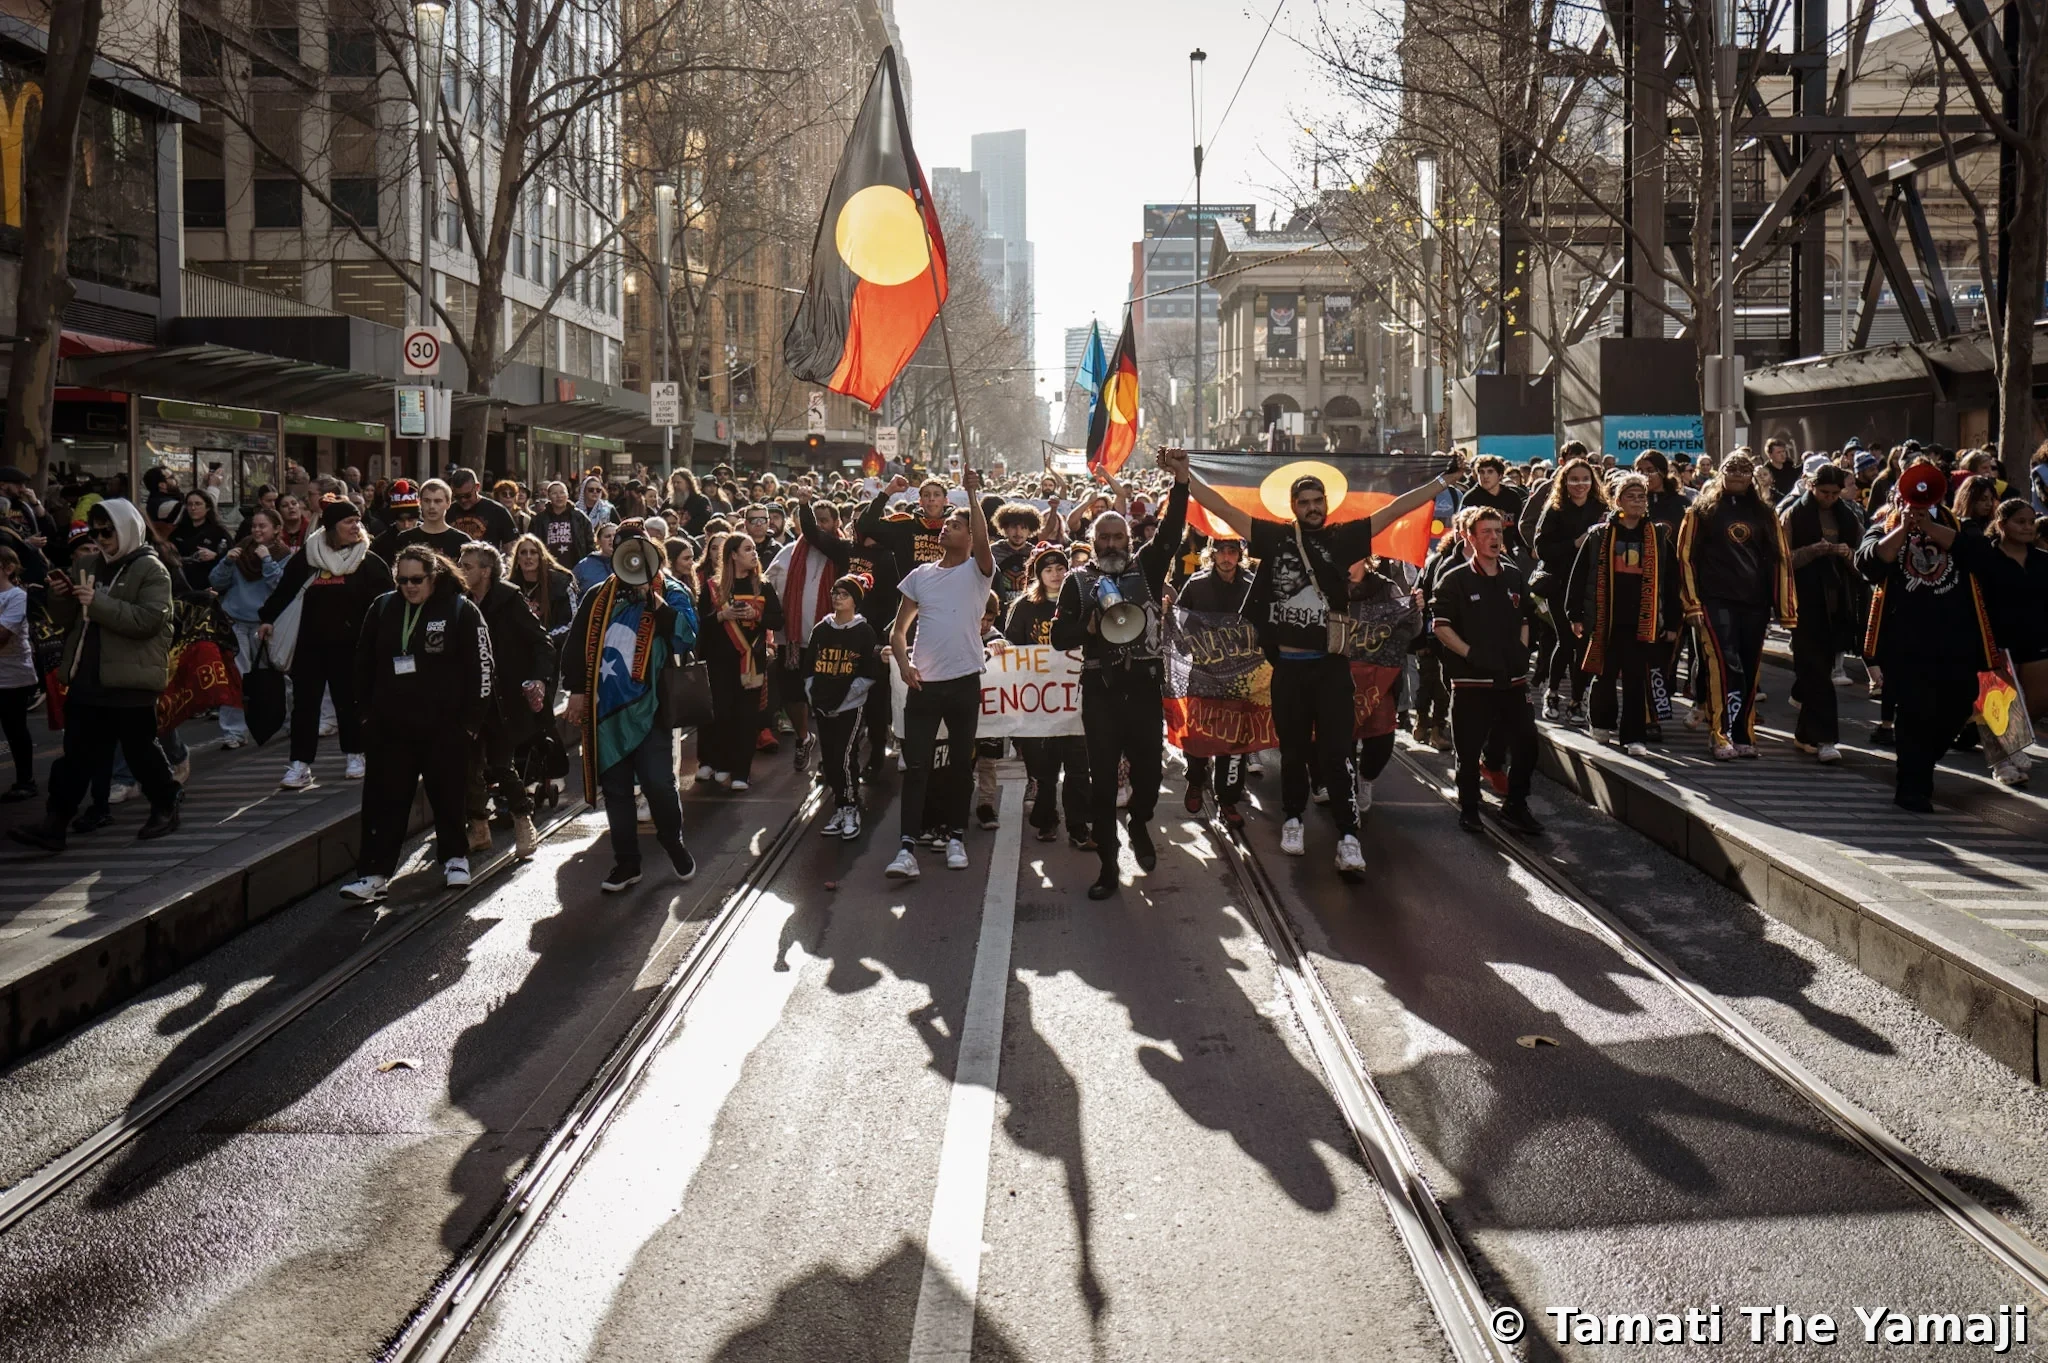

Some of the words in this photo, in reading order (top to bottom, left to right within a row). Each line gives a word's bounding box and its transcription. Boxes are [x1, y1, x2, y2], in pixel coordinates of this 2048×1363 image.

[411, 342, 433, 359] 30
[1618, 430, 1650, 439] MORE
[1652, 430, 1694, 439] TRAINS
[1618, 440, 1657, 450] MORE
[1659, 440, 1704, 450] OFTEN
[390, 492, 418, 502] EAT
[1184, 625, 1261, 667] ALW
[994, 649, 1050, 673] THE
[1065, 650, 1083, 674] S
[196, 661, 229, 691] BE
[1649, 666, 1671, 713] KOORI
[980, 682, 1077, 716] ENOCI
[1186, 698, 1280, 745] ALWAY
